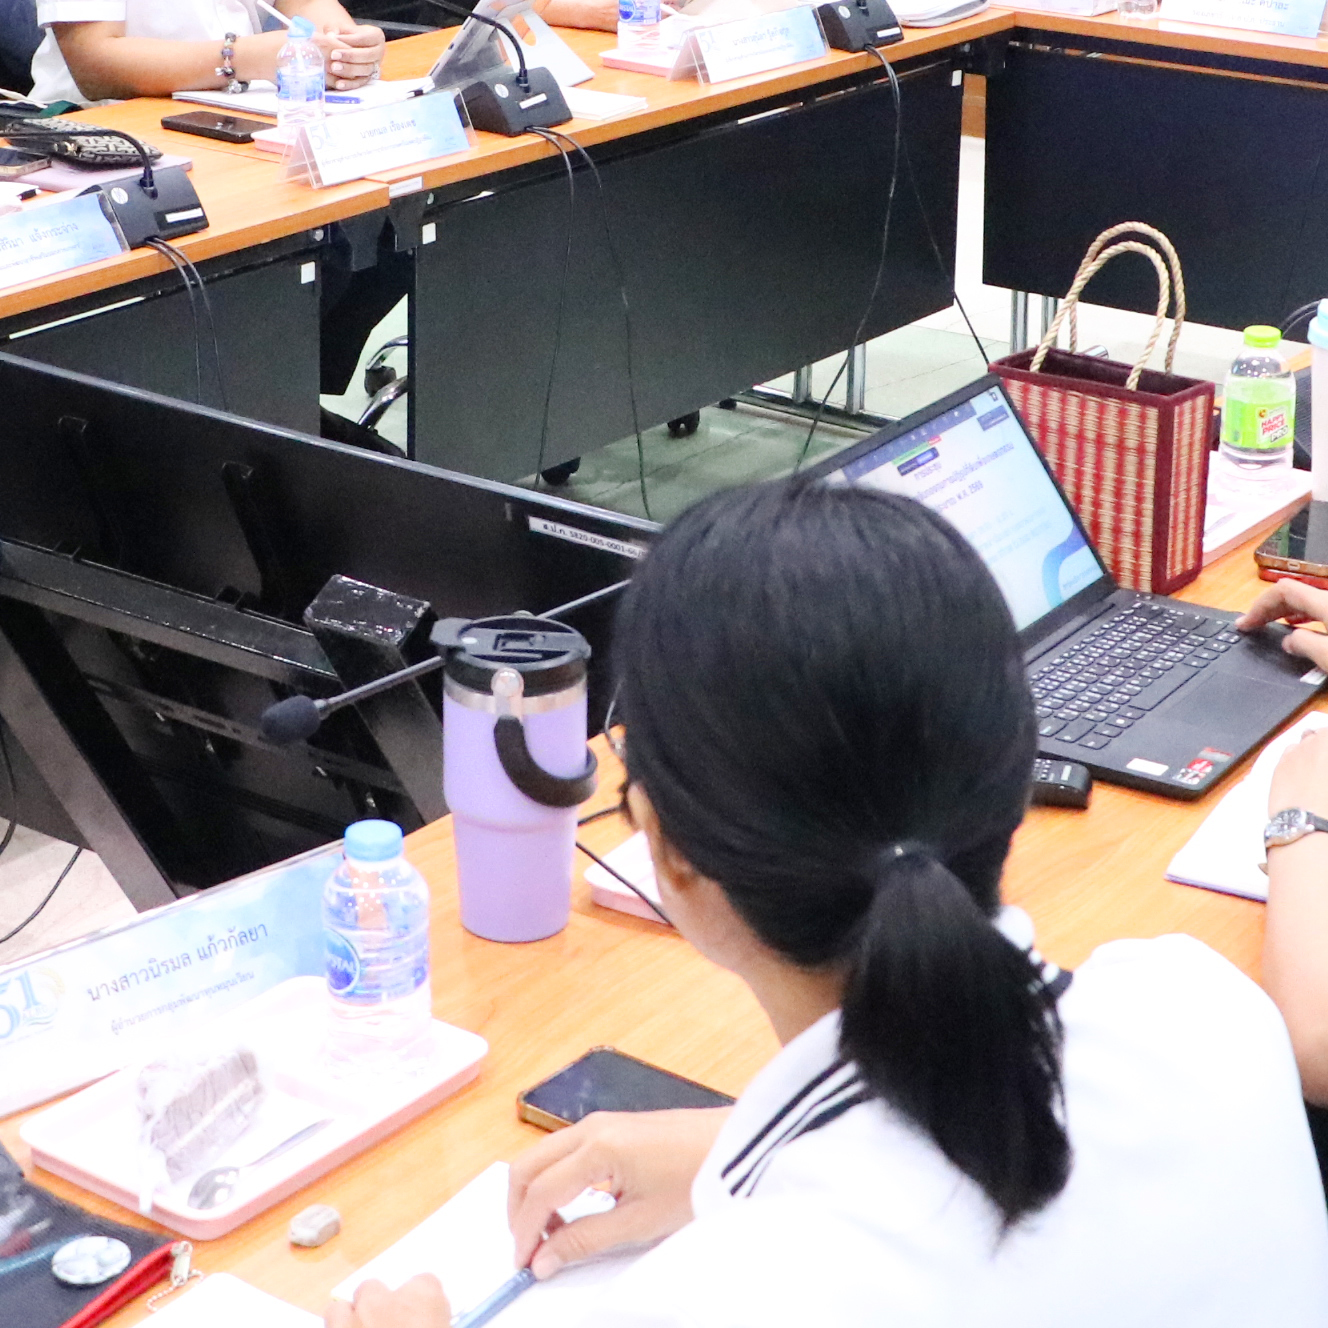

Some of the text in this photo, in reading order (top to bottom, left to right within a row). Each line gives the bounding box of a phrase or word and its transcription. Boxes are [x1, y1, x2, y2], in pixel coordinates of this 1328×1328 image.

[87, 921, 269, 1003] นางสาวนิรมล แก้วกัลยา
